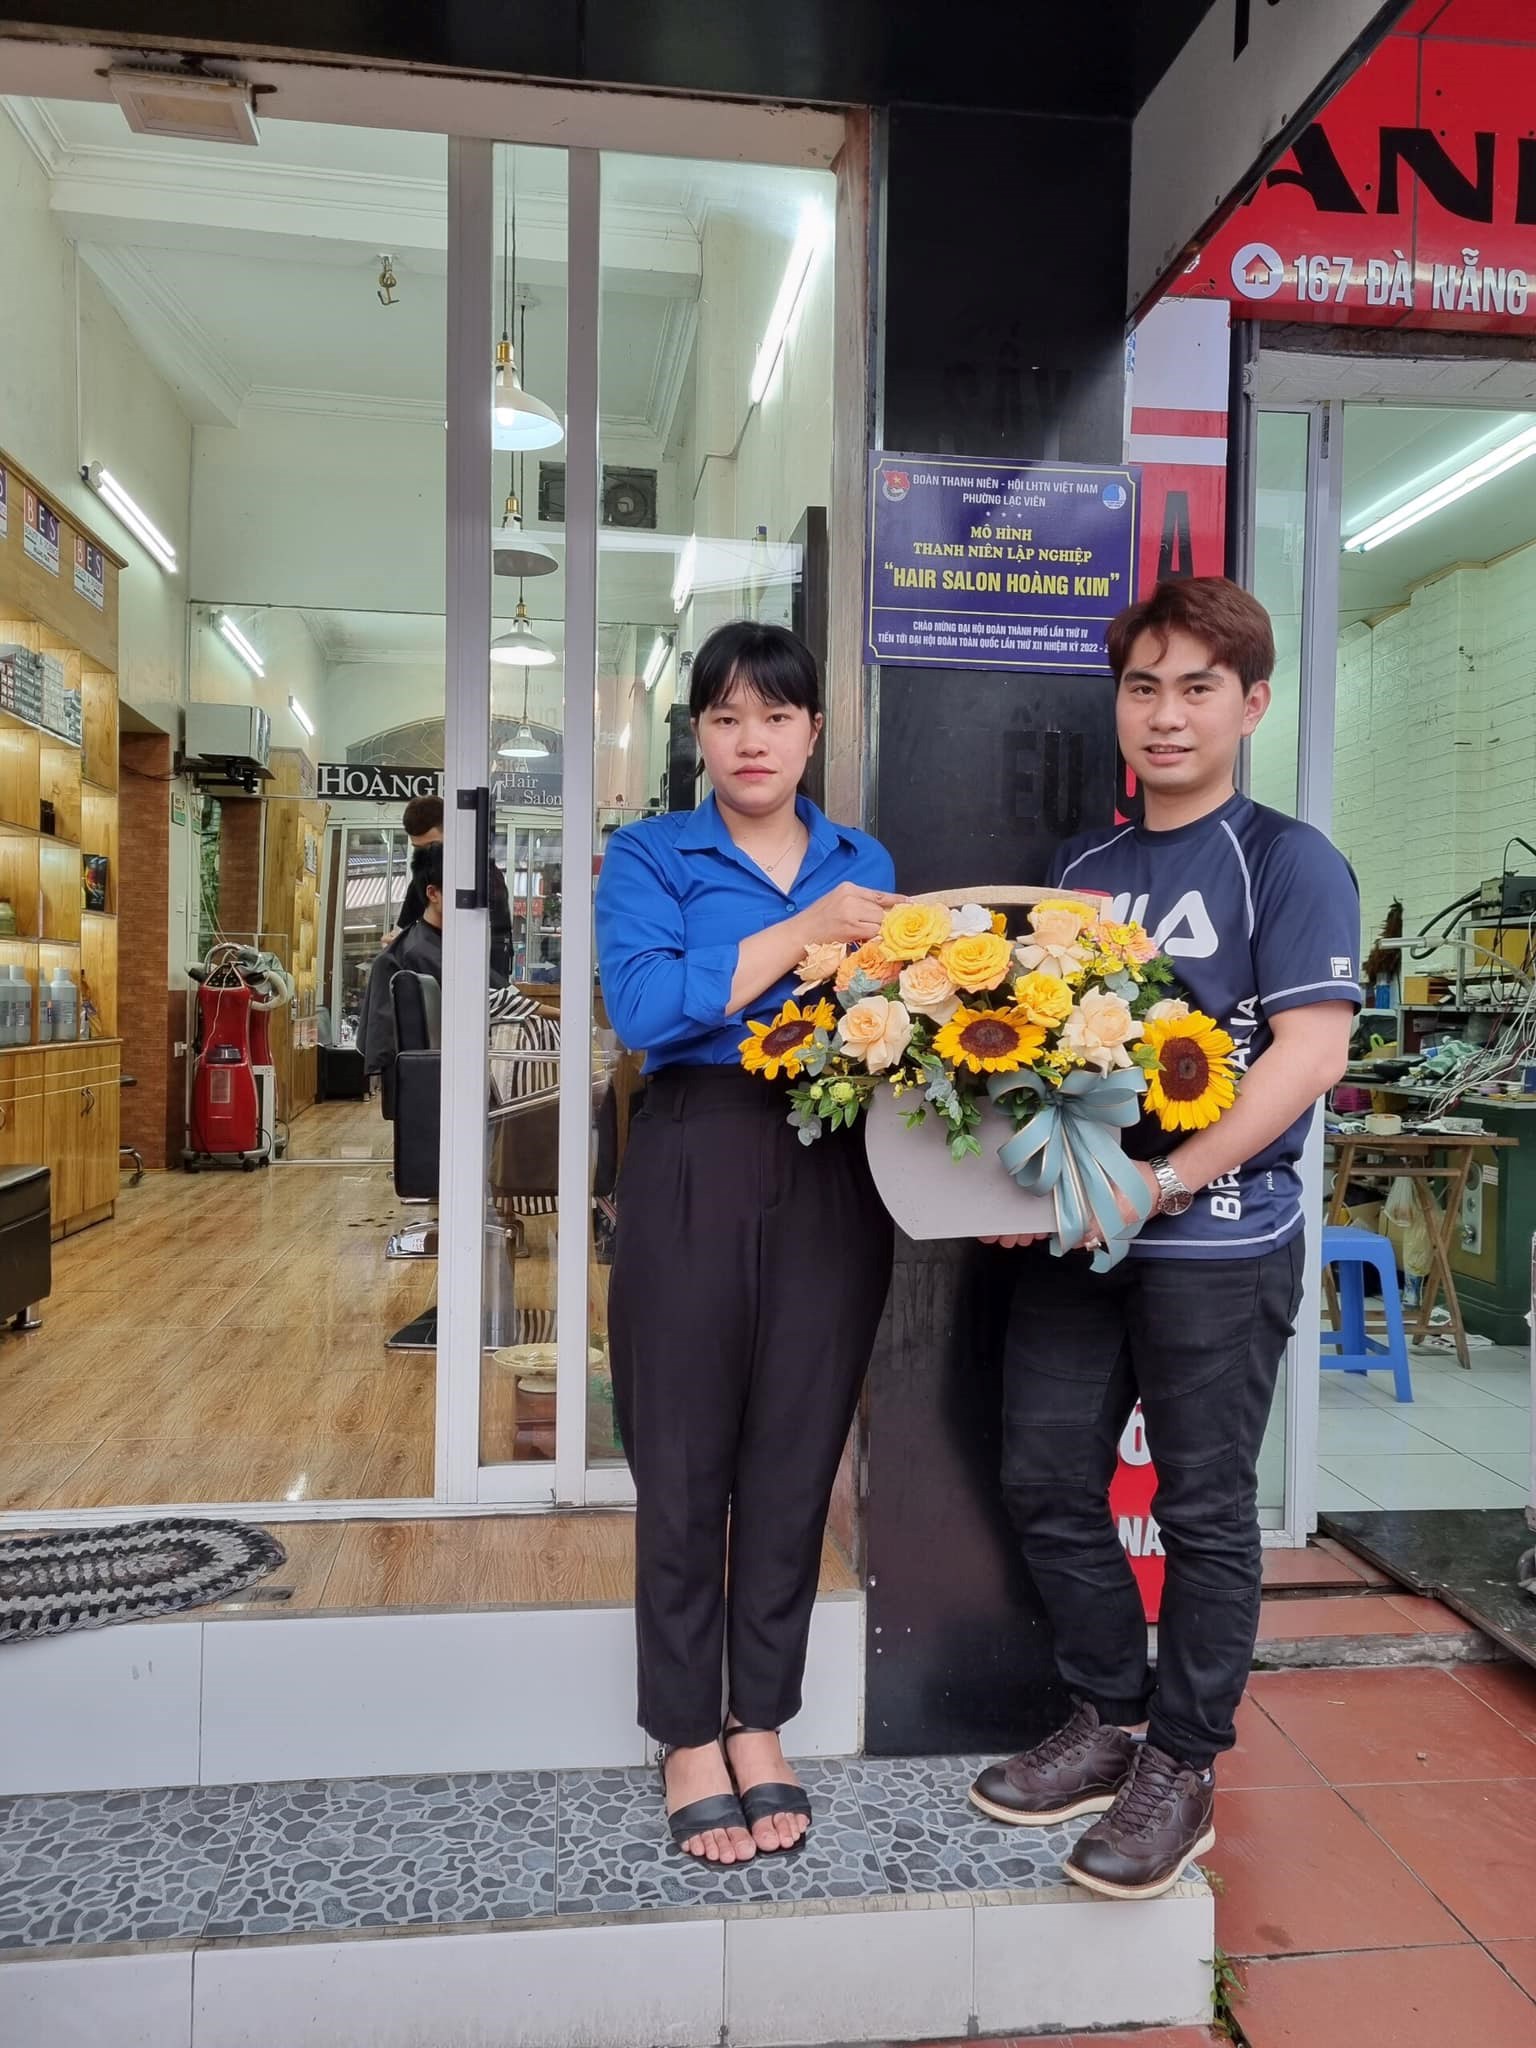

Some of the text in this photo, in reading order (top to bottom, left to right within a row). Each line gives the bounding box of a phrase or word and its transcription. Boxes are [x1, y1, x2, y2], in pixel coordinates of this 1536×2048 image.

[1293, 247, 1529, 316] 167 ĐÀ NẴNG
[912, 473, 940, 486] ĐOÀN
[941, 476, 974, 488] THANH
[976, 476, 999, 489] NIÊN
[1026, 480, 1051, 492] LHTN
[1053, 481, 1075, 494] VIỆT
[1076, 482, 1098, 494] NAM
[962, 491, 1001, 505] PHƯỜNG
[1024, 494, 1046, 507] VIÊN
[970, 523, 1033, 541] MÔ HÌNH
[912, 542, 1093, 566] THANH NIÊN LẬP NGHIỆP
[942, 570, 1001, 593] SALON
[1006, 570, 1069, 596] HOÀNG
[1079, 643, 1098, 653] 2022
[503, 773, 539, 789] Hair
[523, 790, 562, 806] Salon
